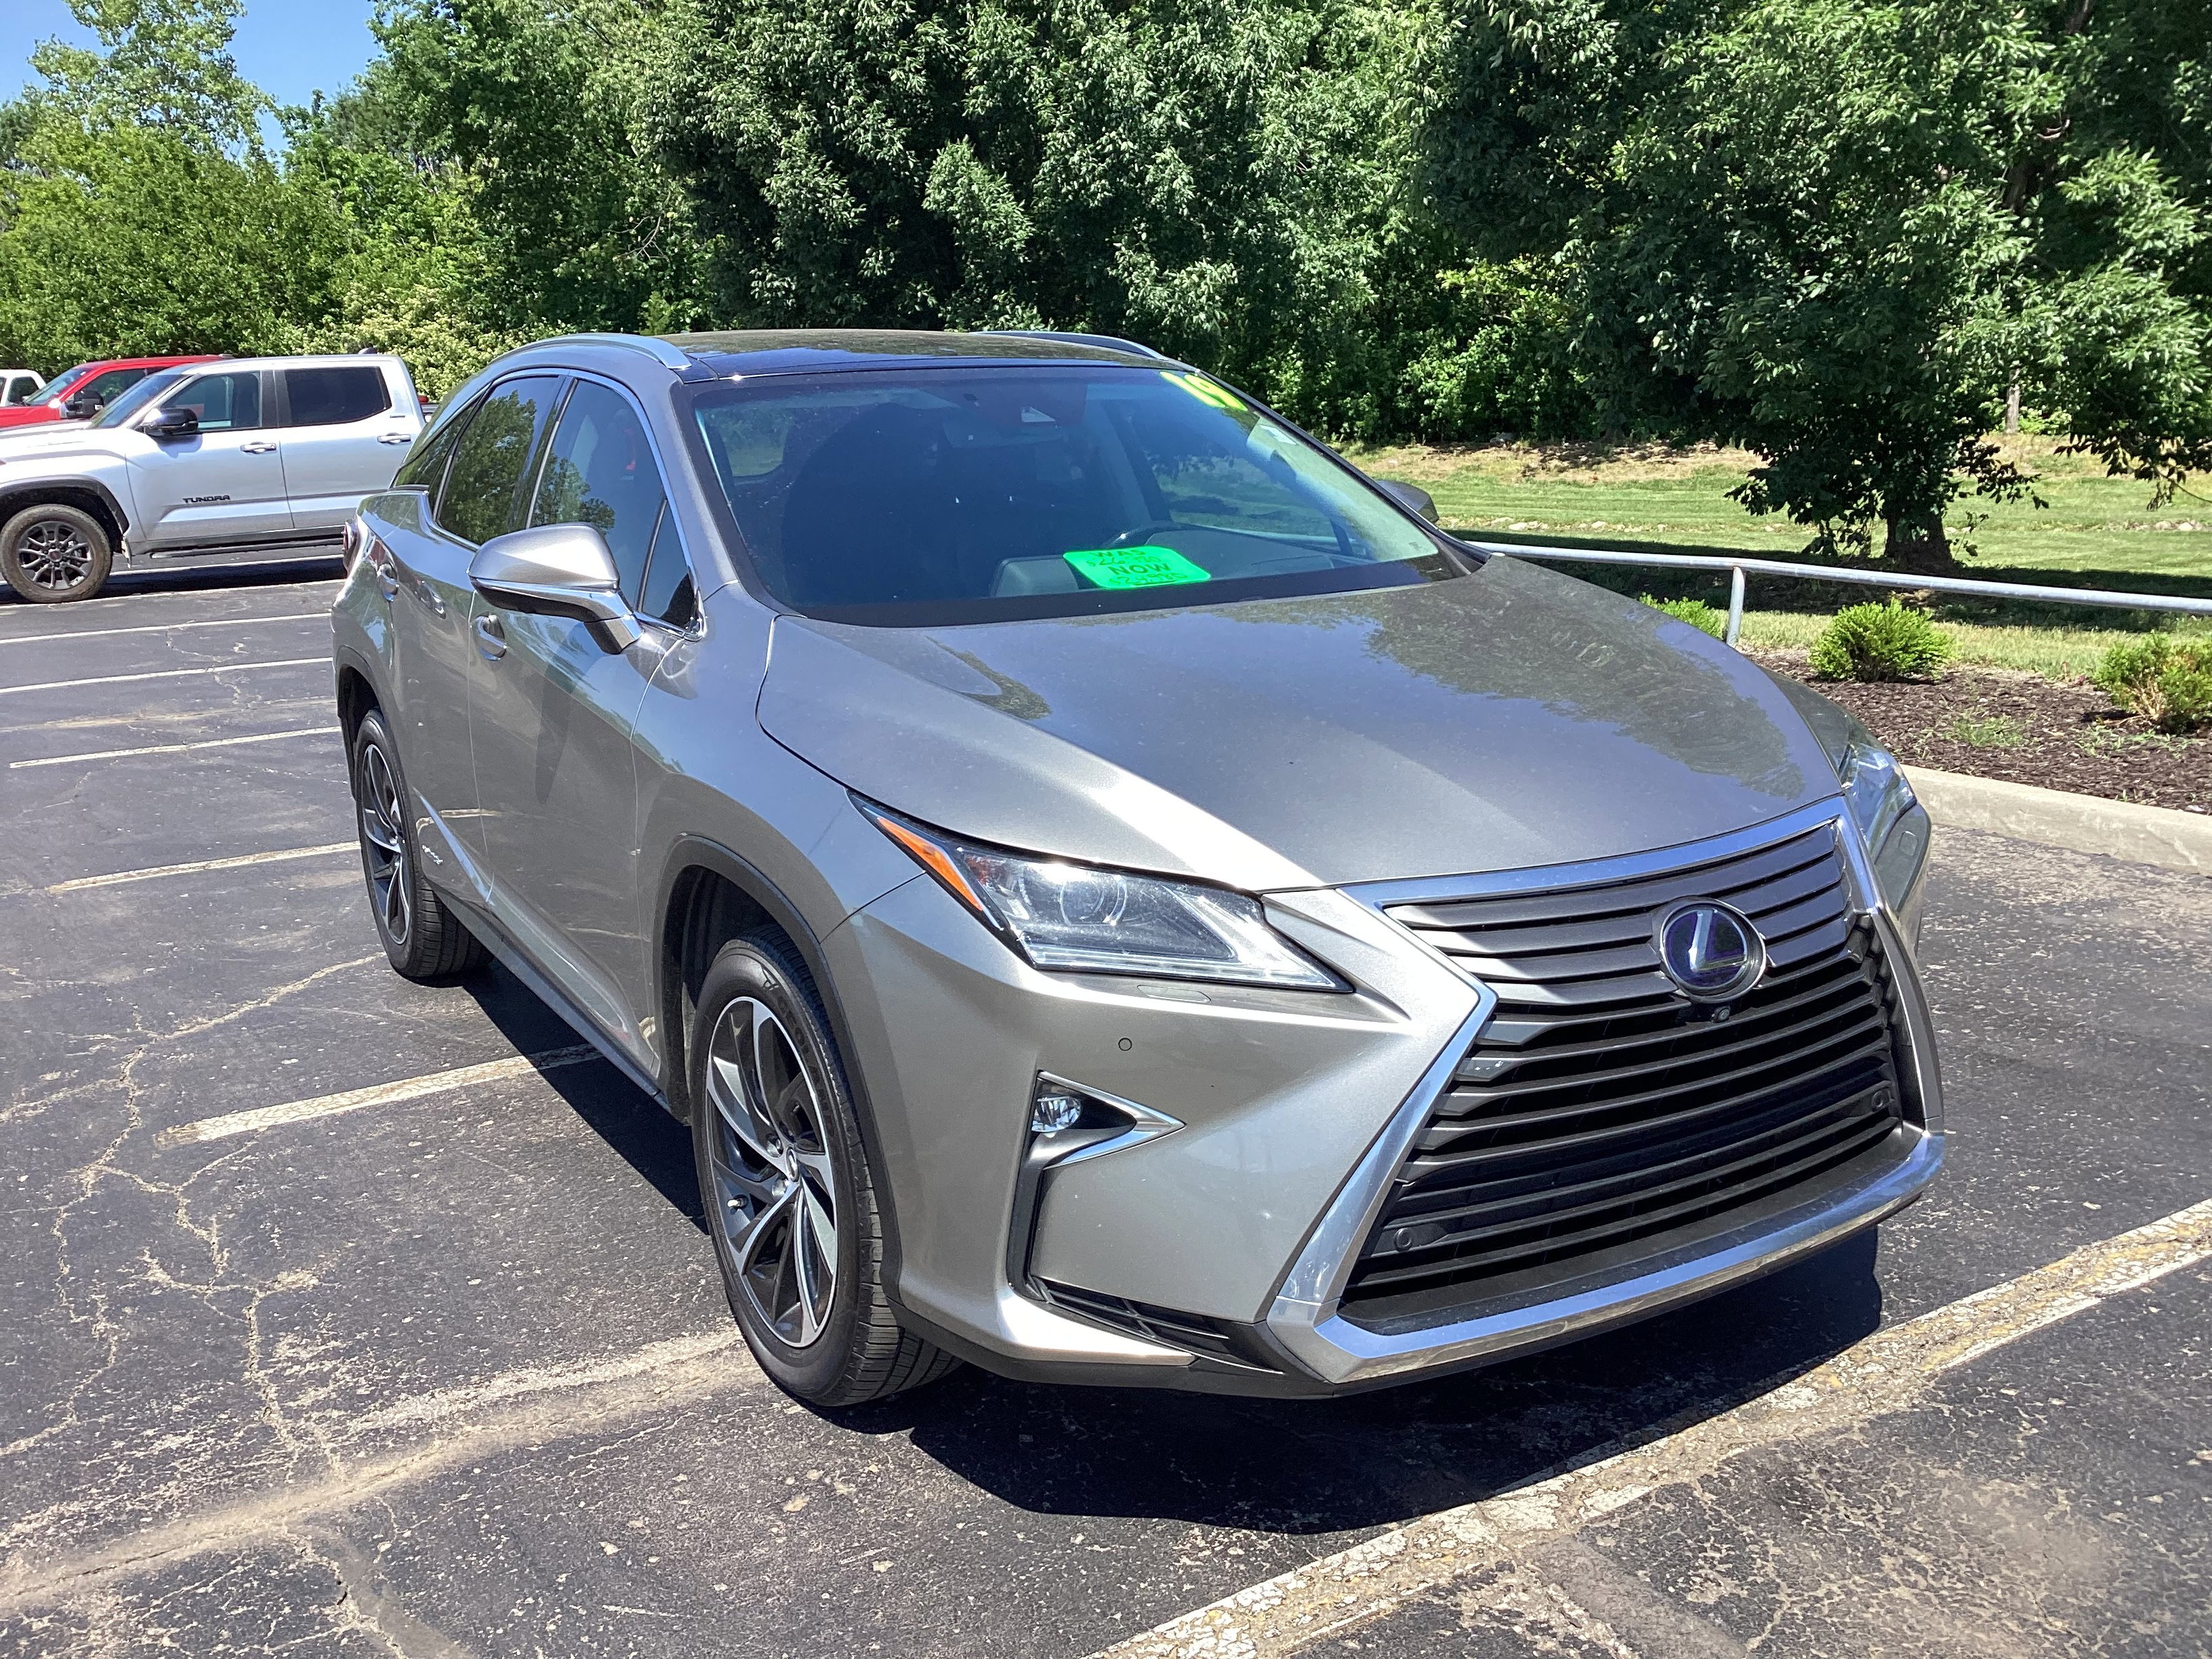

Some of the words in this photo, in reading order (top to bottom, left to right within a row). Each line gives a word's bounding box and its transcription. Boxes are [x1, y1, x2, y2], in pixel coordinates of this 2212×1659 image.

[182, 495, 230, 504] TUNDRA
[1089, 549, 1145, 557] WAS
[1107, 563, 1171, 575] NOW
